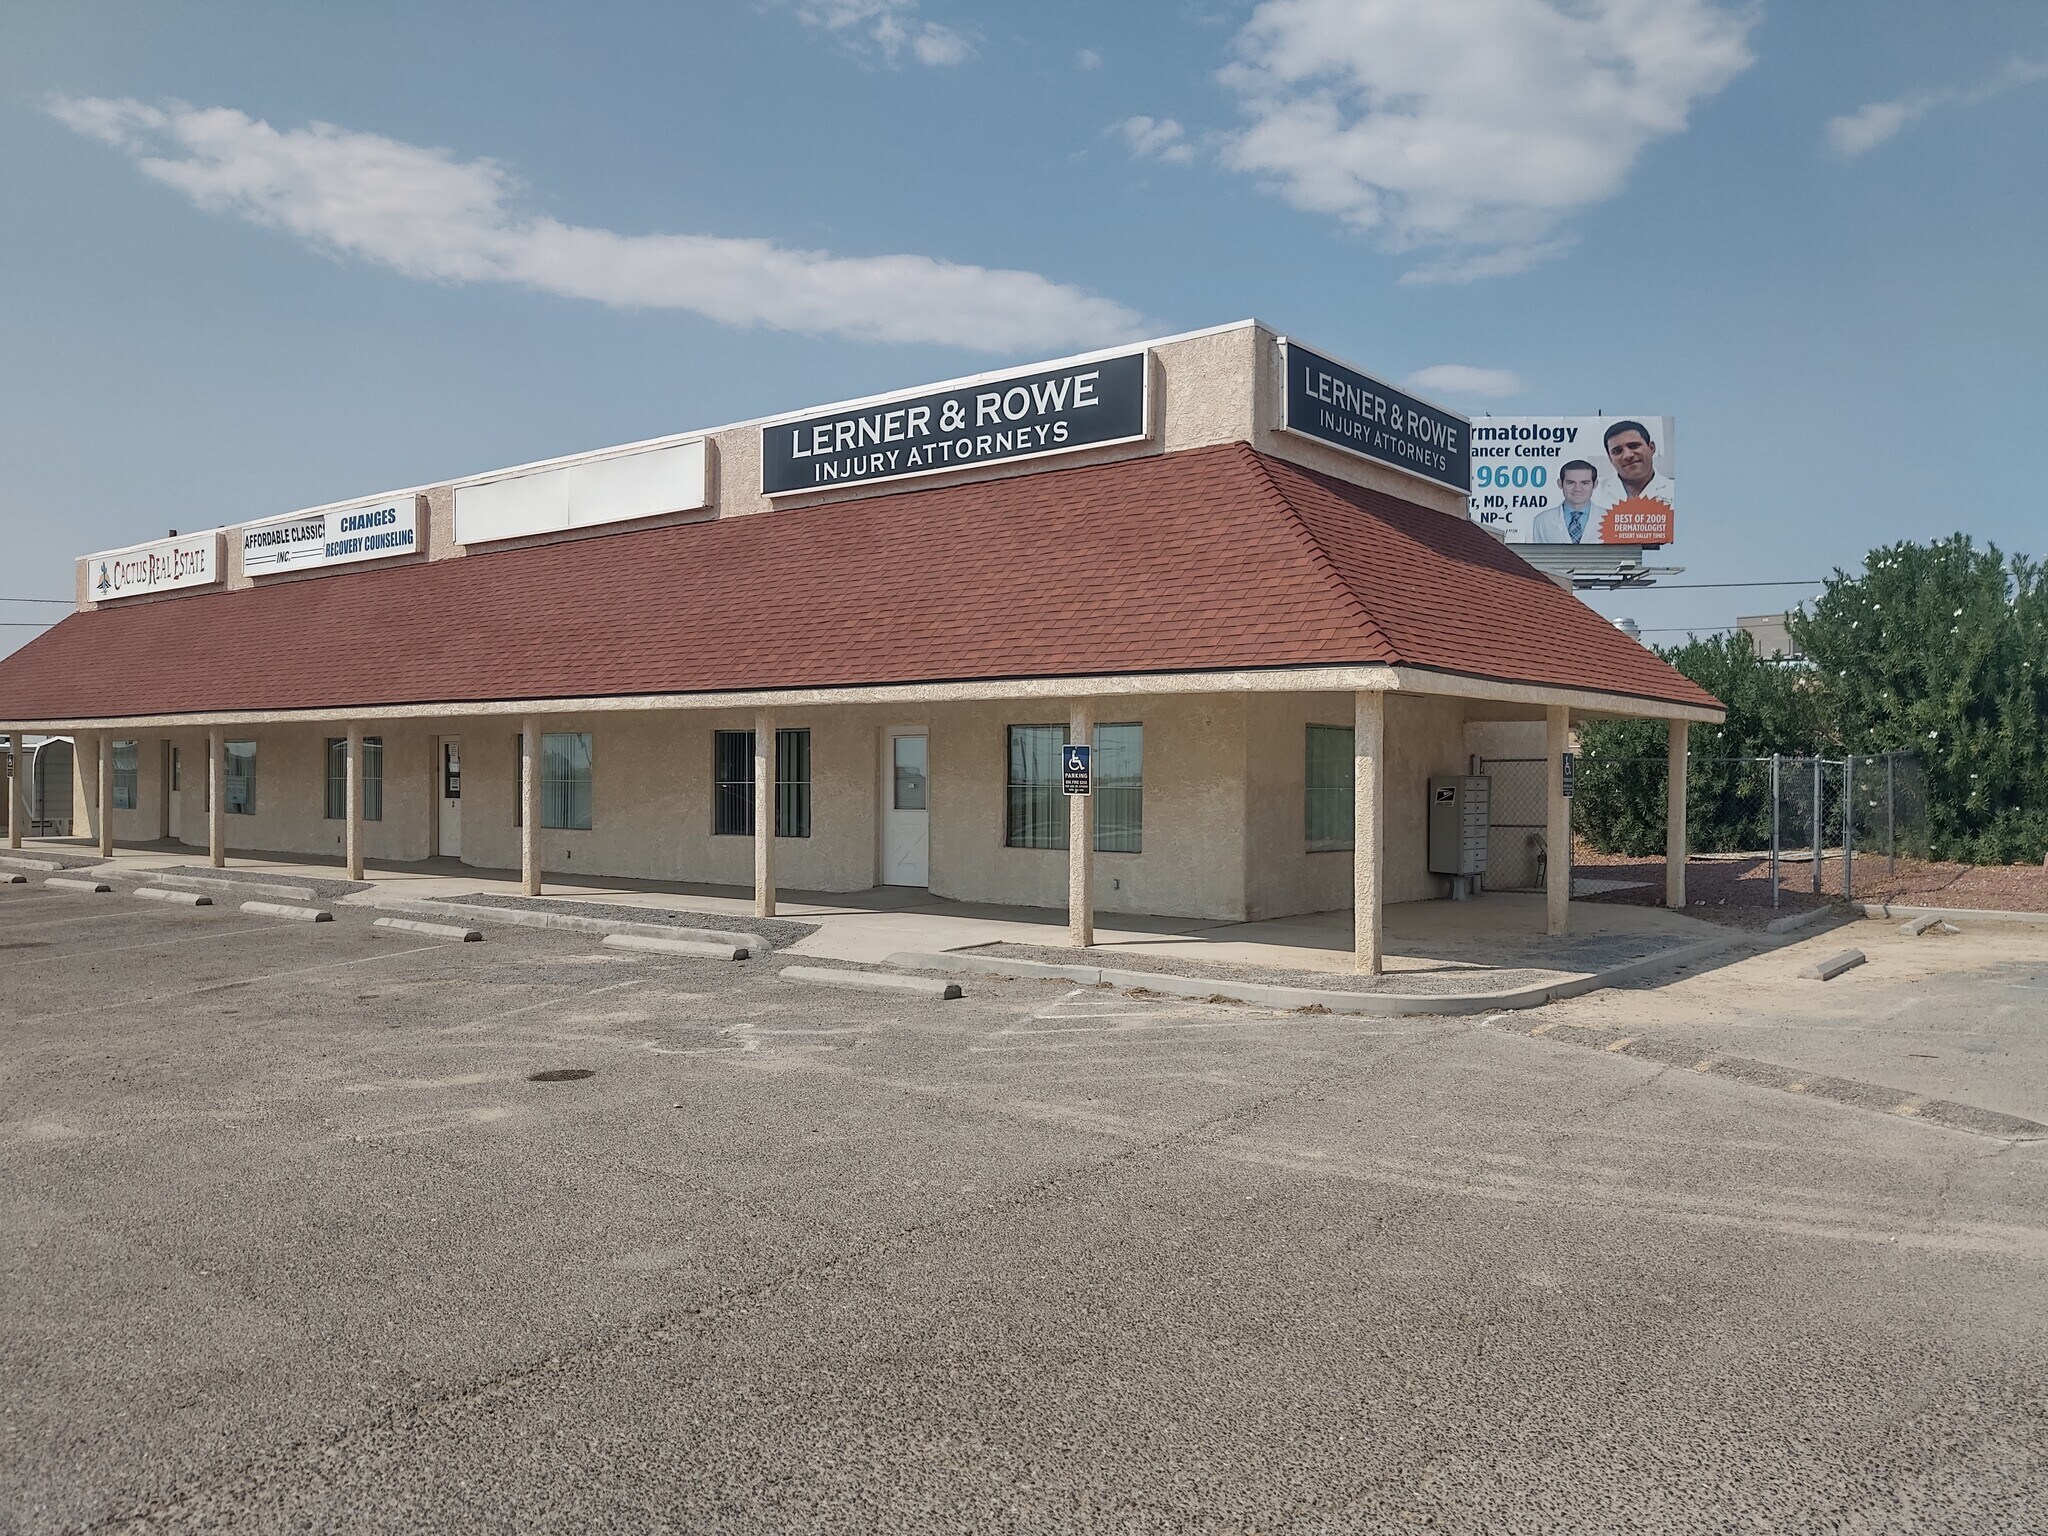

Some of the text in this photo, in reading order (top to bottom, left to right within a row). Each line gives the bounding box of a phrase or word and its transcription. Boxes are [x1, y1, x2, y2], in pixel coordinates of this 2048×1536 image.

[792, 370, 1099, 459] LERNER & ROWE
[1305, 366, 1457, 454] LERNER & ROWE
[1320, 409, 1446, 471] INJURY ATTORNEYS
[1472, 424, 1578, 443] rmatology
[814, 421, 1068, 482] INJURY ATTORNEYS
[1472, 445, 1561, 457] ancer Center
[1484, 496, 1508, 511] MD,
[1512, 496, 1548, 508] FAAD
[340, 508, 396, 533] CHANGES
[1480, 513, 1513, 524] NP-C
[1614, 514, 1666, 523] BEST OF 2009
[1614, 524, 1666, 532] DERMATOLOGIST
[244, 527, 289, 550] AFFORDABLE
[325, 529, 414, 558] RECOVERY COUNSELING
[276, 551, 291, 564] INC.
